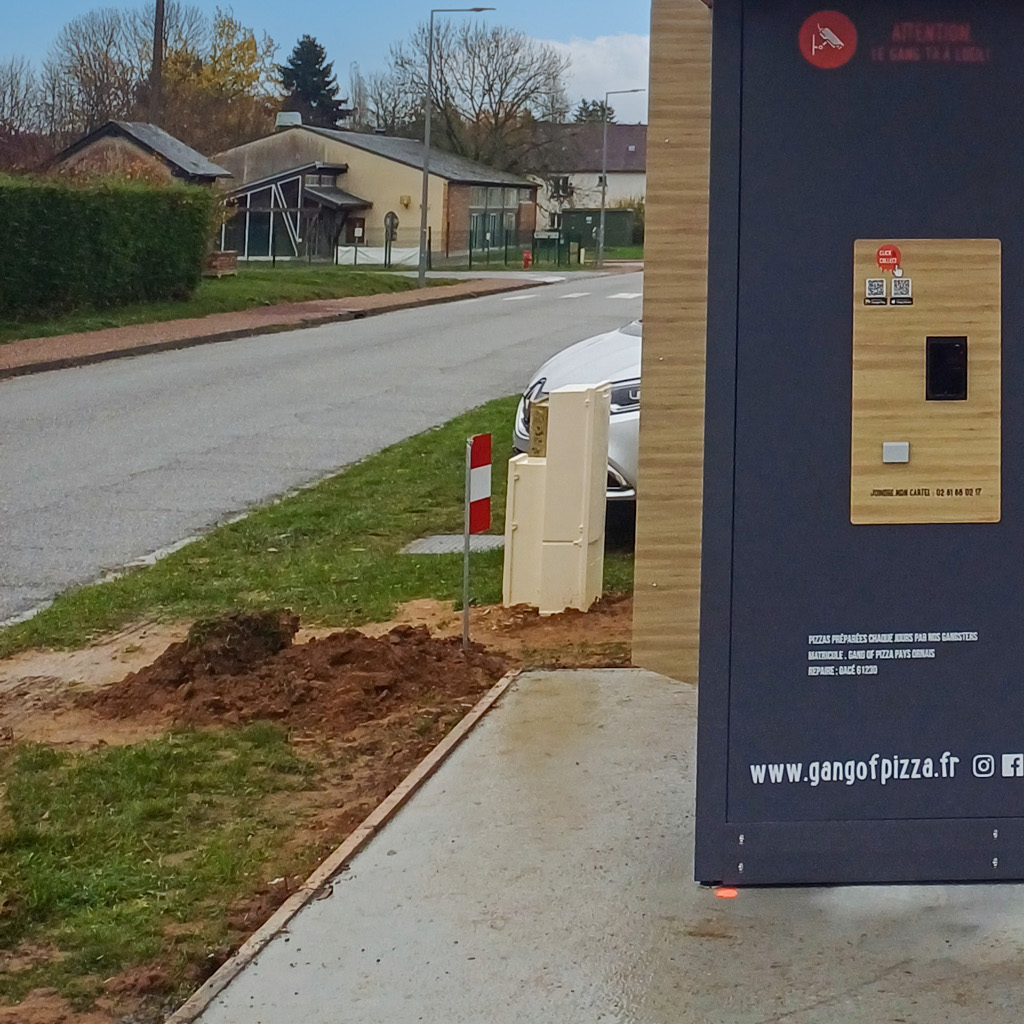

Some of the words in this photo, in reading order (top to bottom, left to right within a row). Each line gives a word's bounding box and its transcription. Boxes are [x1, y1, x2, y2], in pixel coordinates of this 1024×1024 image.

[909, 488, 931, 496] CARTEL
[808, 634, 830, 644] PIZZAS
[831, 632, 867, 644] PRÉPARÉES
[868, 633, 893, 643] CHAQUE
[914, 632, 927, 642] PAR
[927, 632, 941, 642] NOS
[941, 631, 978, 642] GANGSTERS
[808, 650, 843, 660] MATRICULE
[848, 650, 865, 660] GANG
[866, 649, 875, 659] OF
[875, 649, 894, 659] PIZZA
[894, 649, 911, 659] PAYS
[856, 665, 878, 675] 61230
[750, 751, 960, 787] www.gangofpizza.fr
